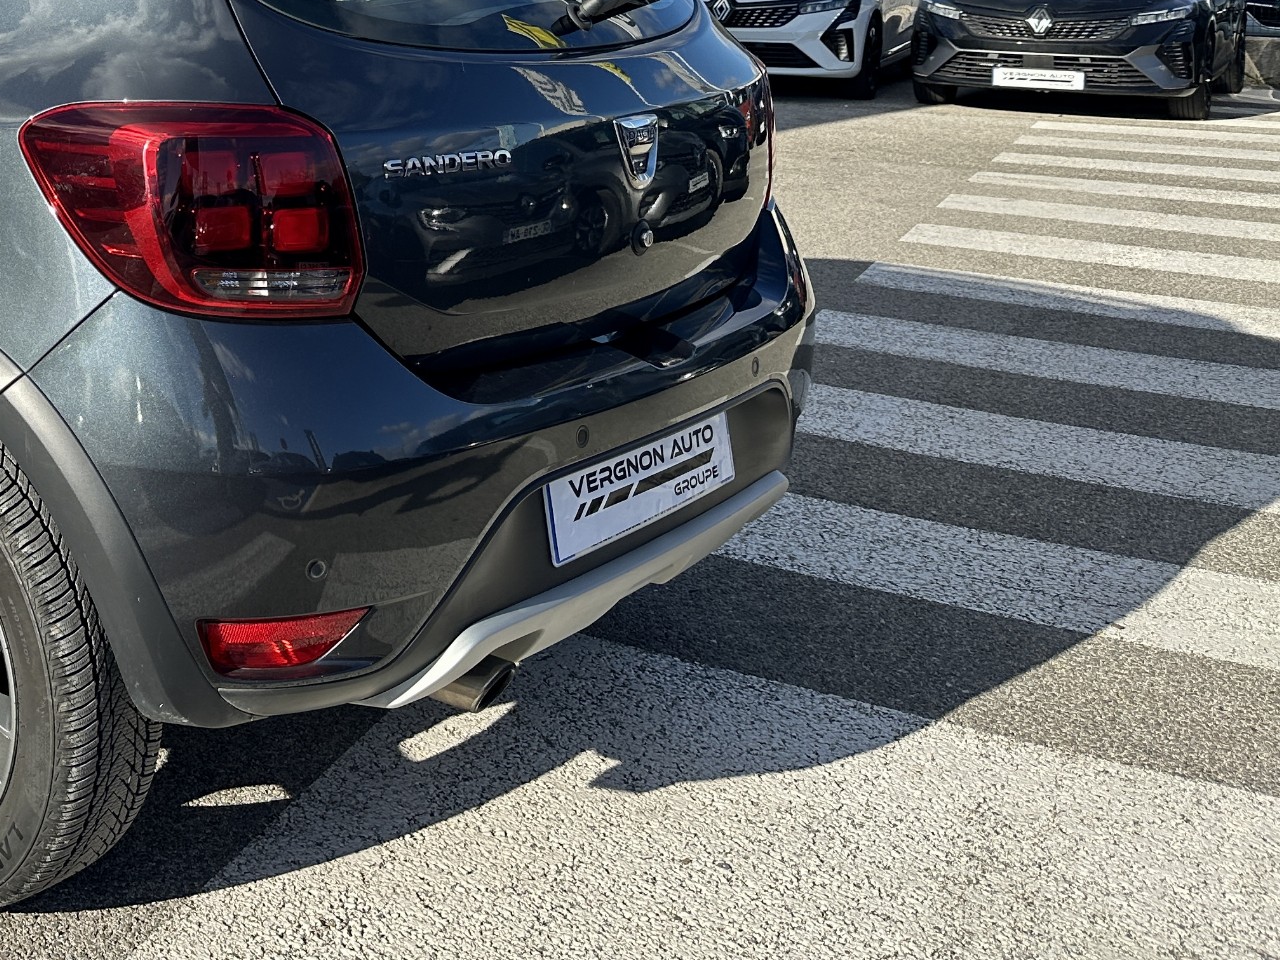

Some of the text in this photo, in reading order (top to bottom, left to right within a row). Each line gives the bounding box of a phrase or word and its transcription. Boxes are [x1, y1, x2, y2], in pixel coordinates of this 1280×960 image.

[383, 150, 512, 178] SANDERO
[568, 425, 714, 498] VERGNON AUTO
[674, 464, 720, 496] GROUPE
